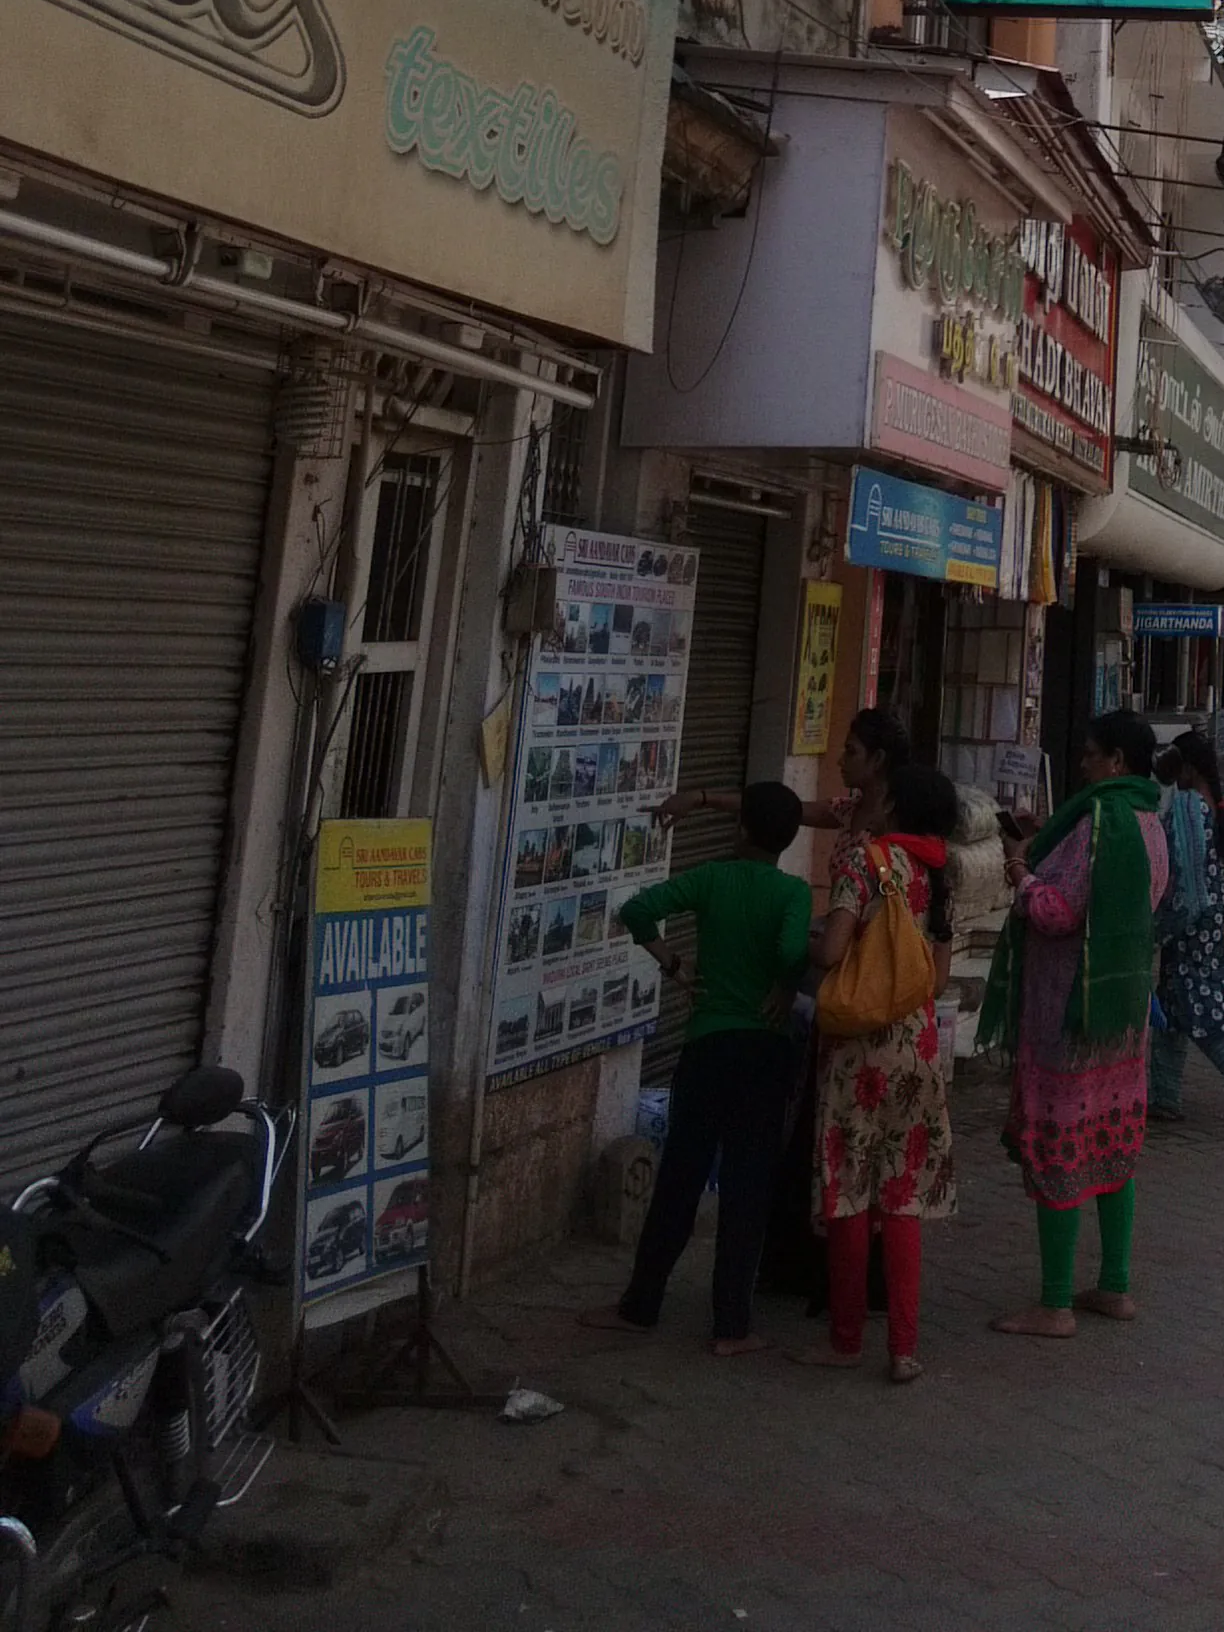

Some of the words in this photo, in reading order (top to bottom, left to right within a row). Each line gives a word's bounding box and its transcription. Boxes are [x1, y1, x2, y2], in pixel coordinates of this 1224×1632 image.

[386, 25, 625, 246] textiles
[1063, 355, 1111, 436] BHAVAN
[1134, 616, 1214, 631] JIGARTHANDA
[355, 870, 382, 888] TOURS
[383, 870, 390, 888] &
[392, 867, 427, 886] TRAVELS
[319, 914, 428, 985] AVAILABLE
[489, 1063, 535, 1093] AVAILABLE
